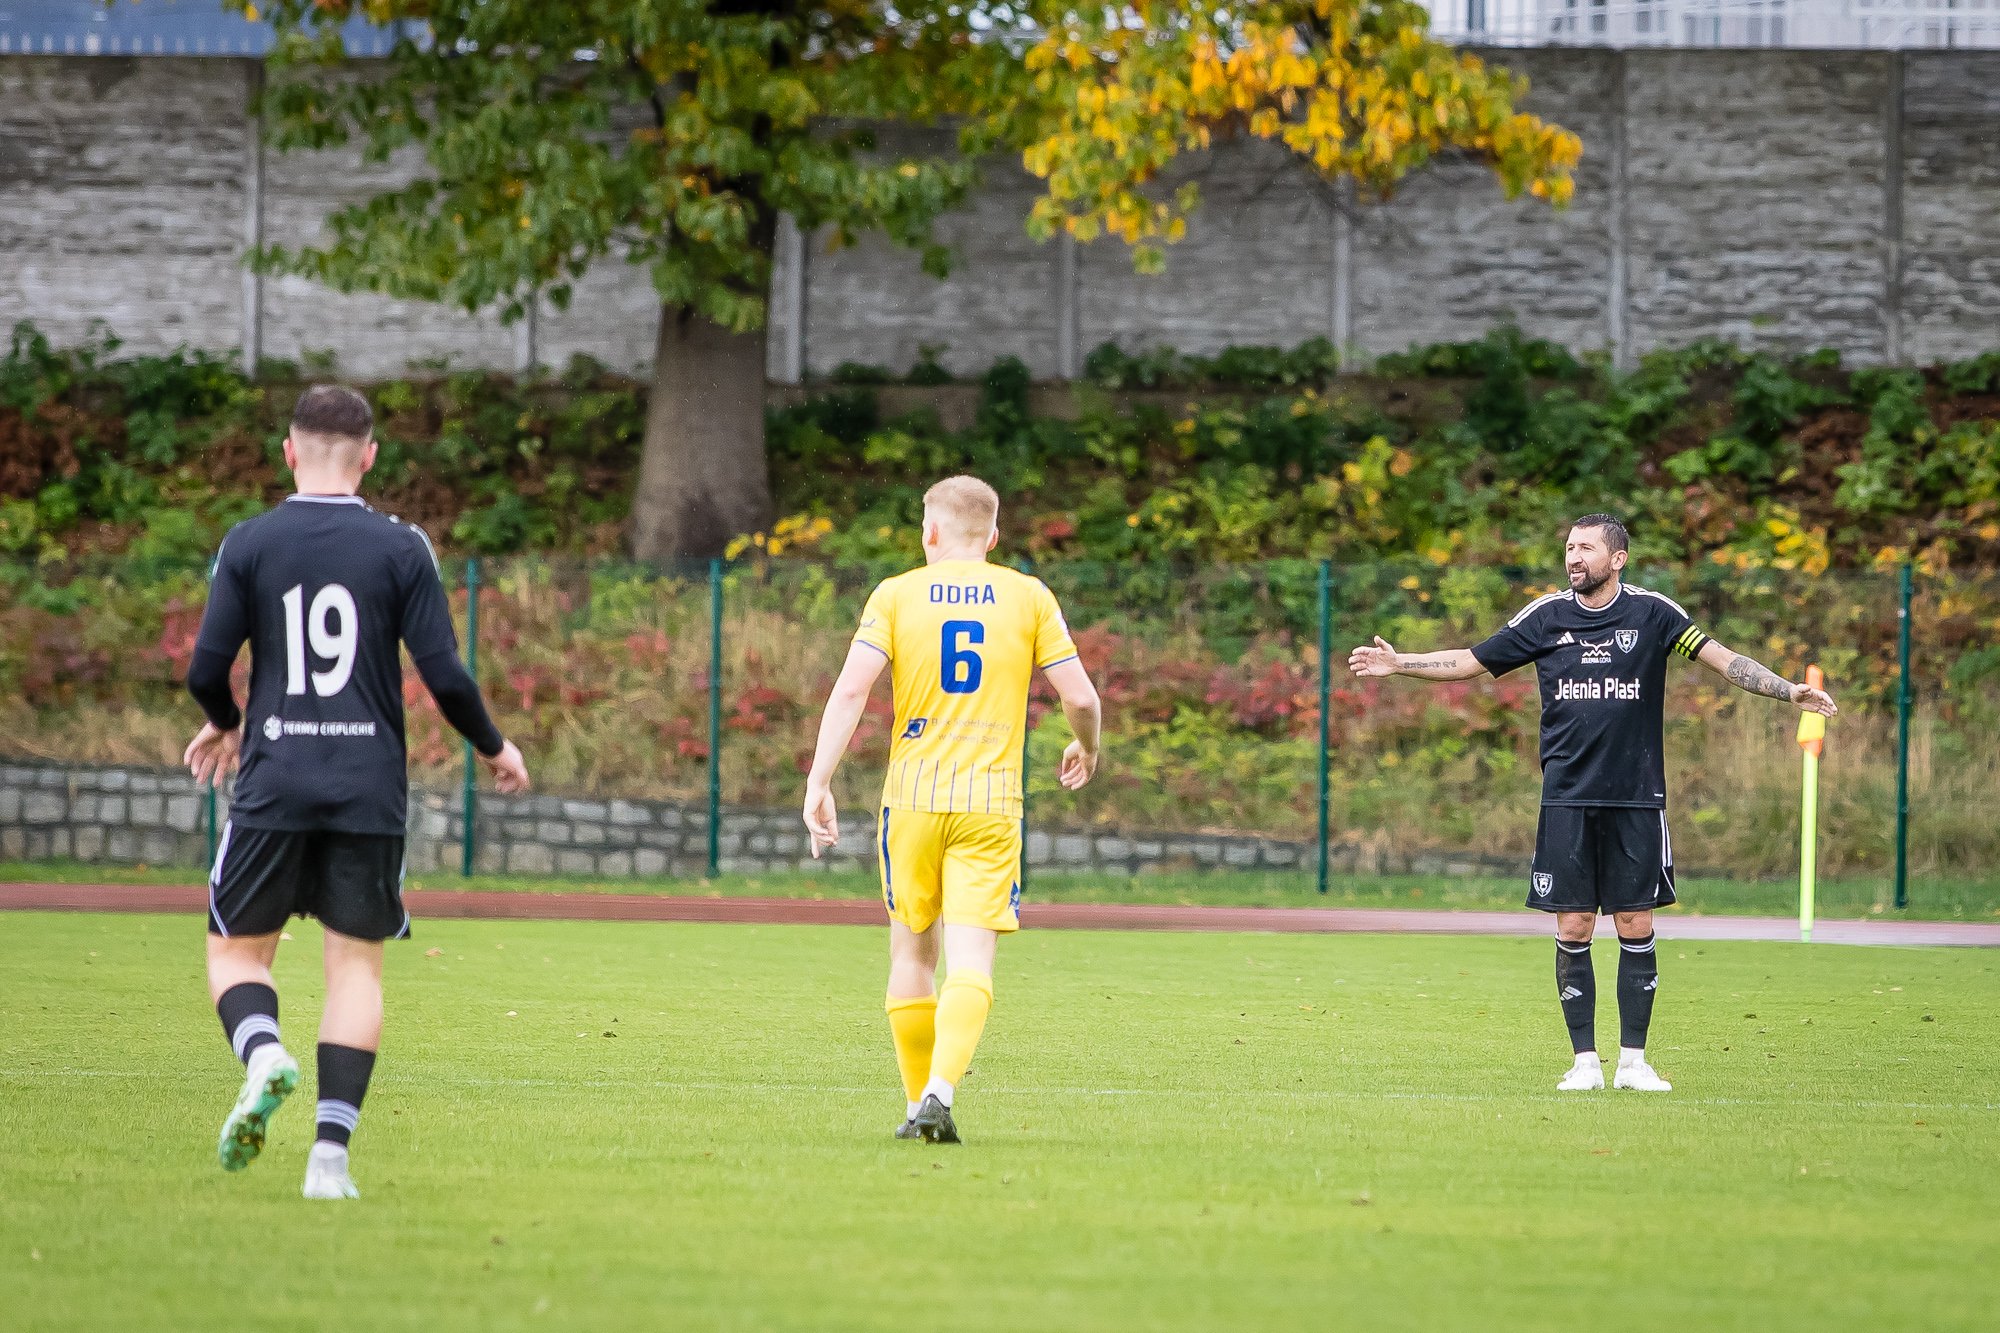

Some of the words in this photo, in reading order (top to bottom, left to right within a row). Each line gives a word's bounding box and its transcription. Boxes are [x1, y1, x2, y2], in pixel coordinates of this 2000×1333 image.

[930, 584, 996, 604] ODRA
[282, 583, 359, 697] 19
[941, 620, 985, 694] 6
[1555, 678, 1600, 700] Jelenia
[1604, 678, 1640, 700] Plast
